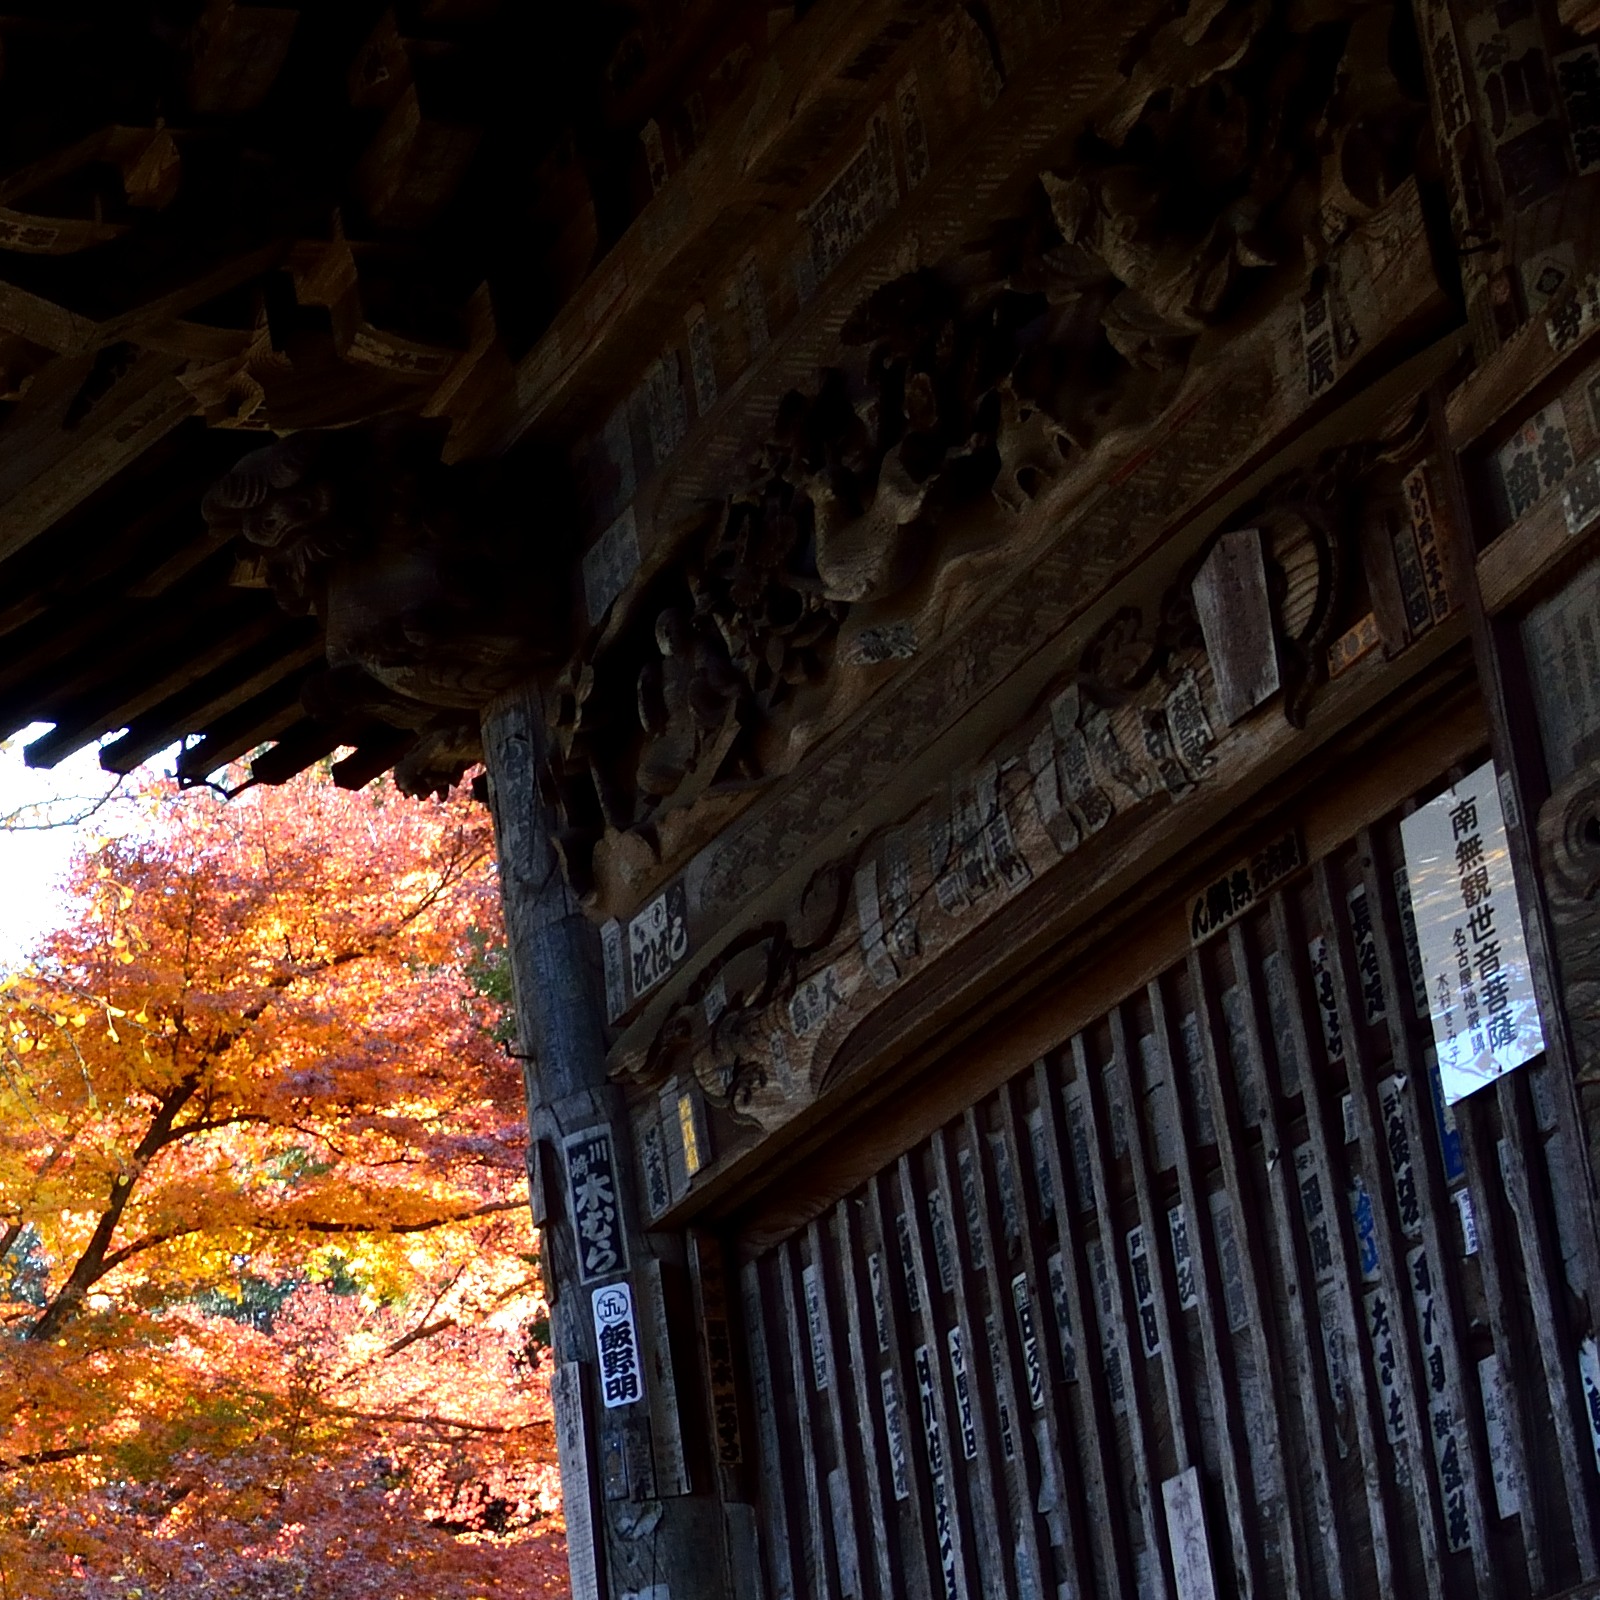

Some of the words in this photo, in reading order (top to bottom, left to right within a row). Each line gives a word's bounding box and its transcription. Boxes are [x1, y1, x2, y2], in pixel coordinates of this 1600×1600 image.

[1448, 795, 1518, 1054] 南無観世音菩薩
[599, 1321, 638, 1402] 飯野明
